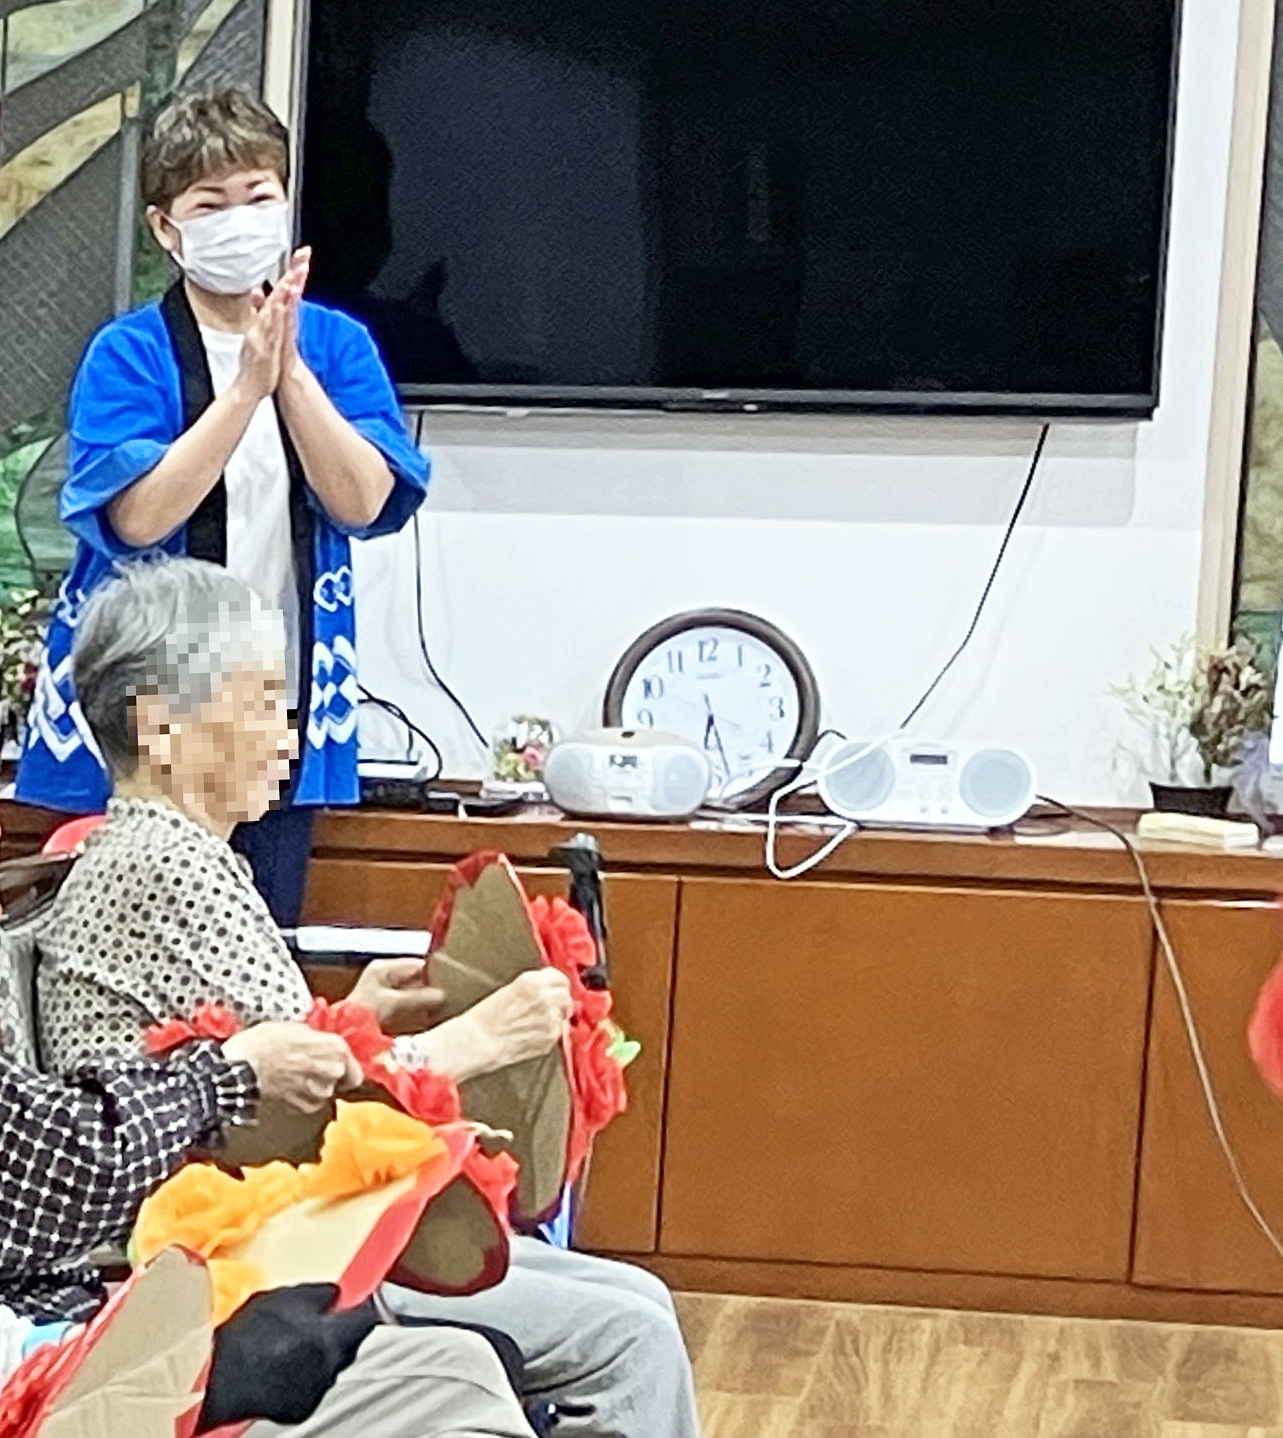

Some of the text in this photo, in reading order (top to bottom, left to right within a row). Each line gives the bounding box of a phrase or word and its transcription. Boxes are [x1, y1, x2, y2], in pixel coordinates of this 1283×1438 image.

[667, 650, 684, 673] 11
[698, 637, 718, 663] 12
[737, 644, 743, 668] 1
[643, 674, 664, 700] 10
[757, 663, 772, 688] 2
[768, 696, 785, 721] 3
